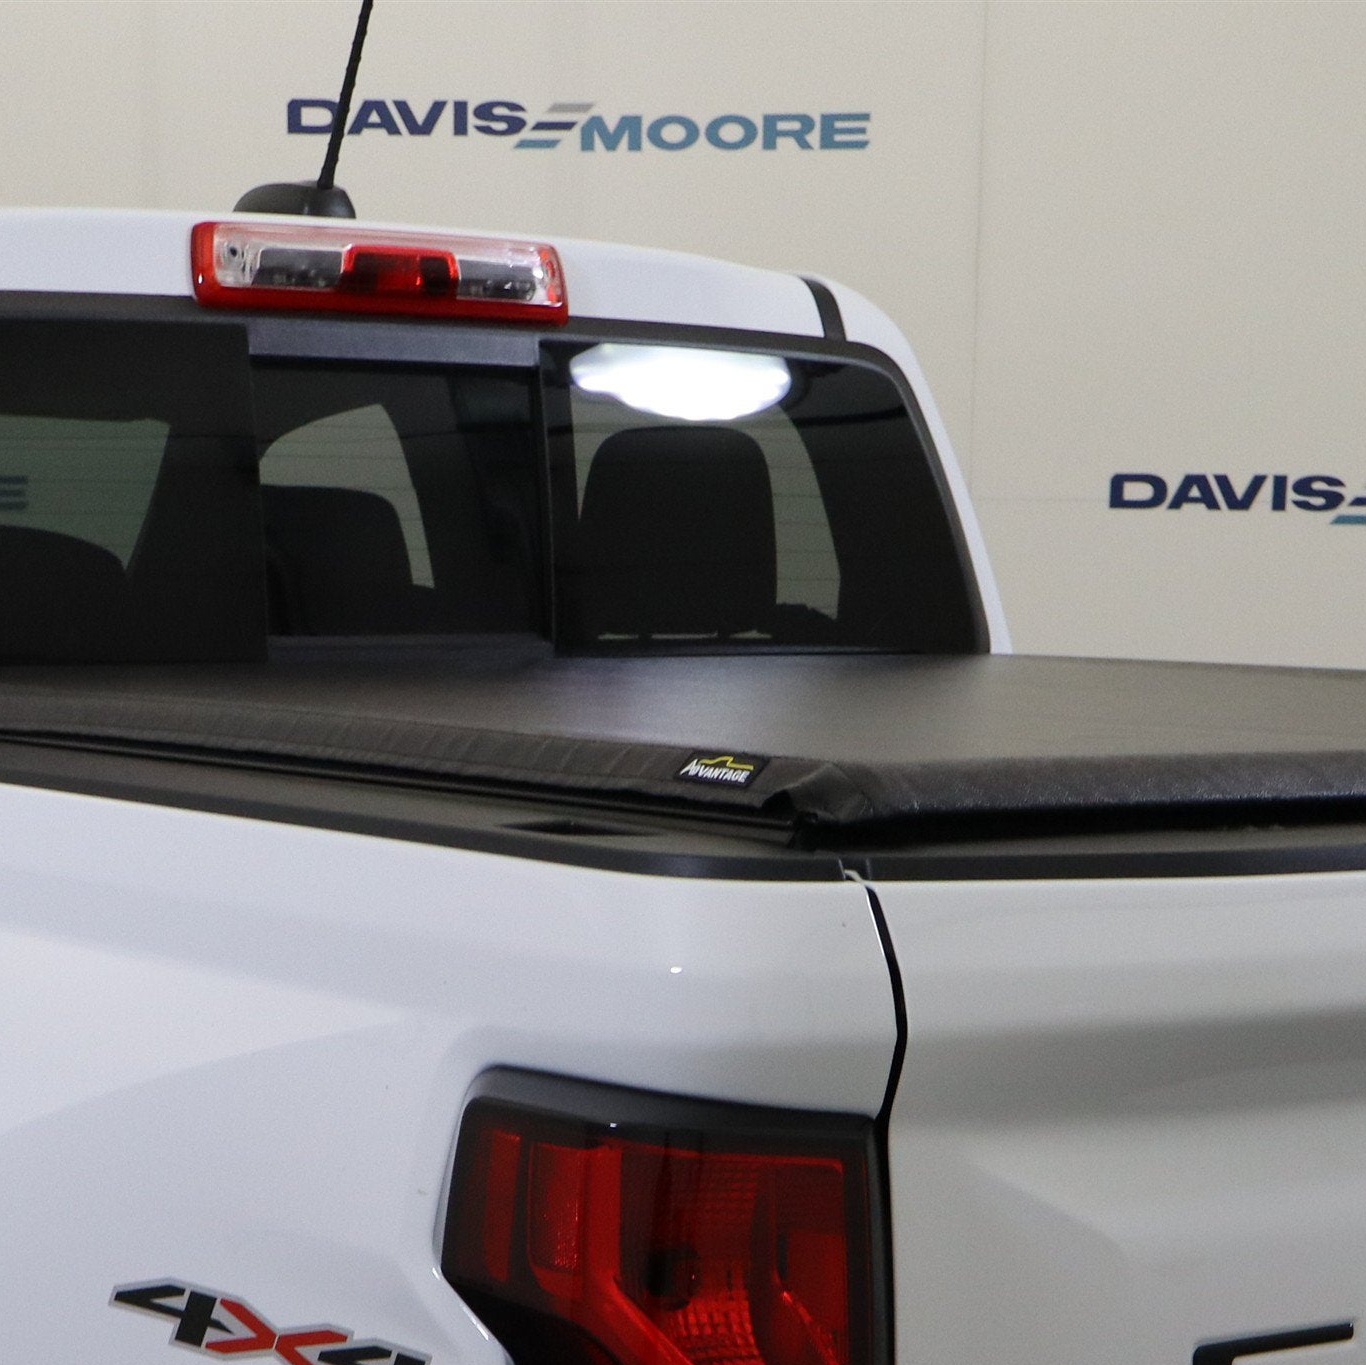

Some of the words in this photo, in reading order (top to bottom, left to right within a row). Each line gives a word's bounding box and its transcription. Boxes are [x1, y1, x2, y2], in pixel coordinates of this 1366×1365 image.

[287, 98, 528, 136] DAVIS
[579, 112, 871, 152] MOORE
[1108, 473, 1346, 512] DAVIS
